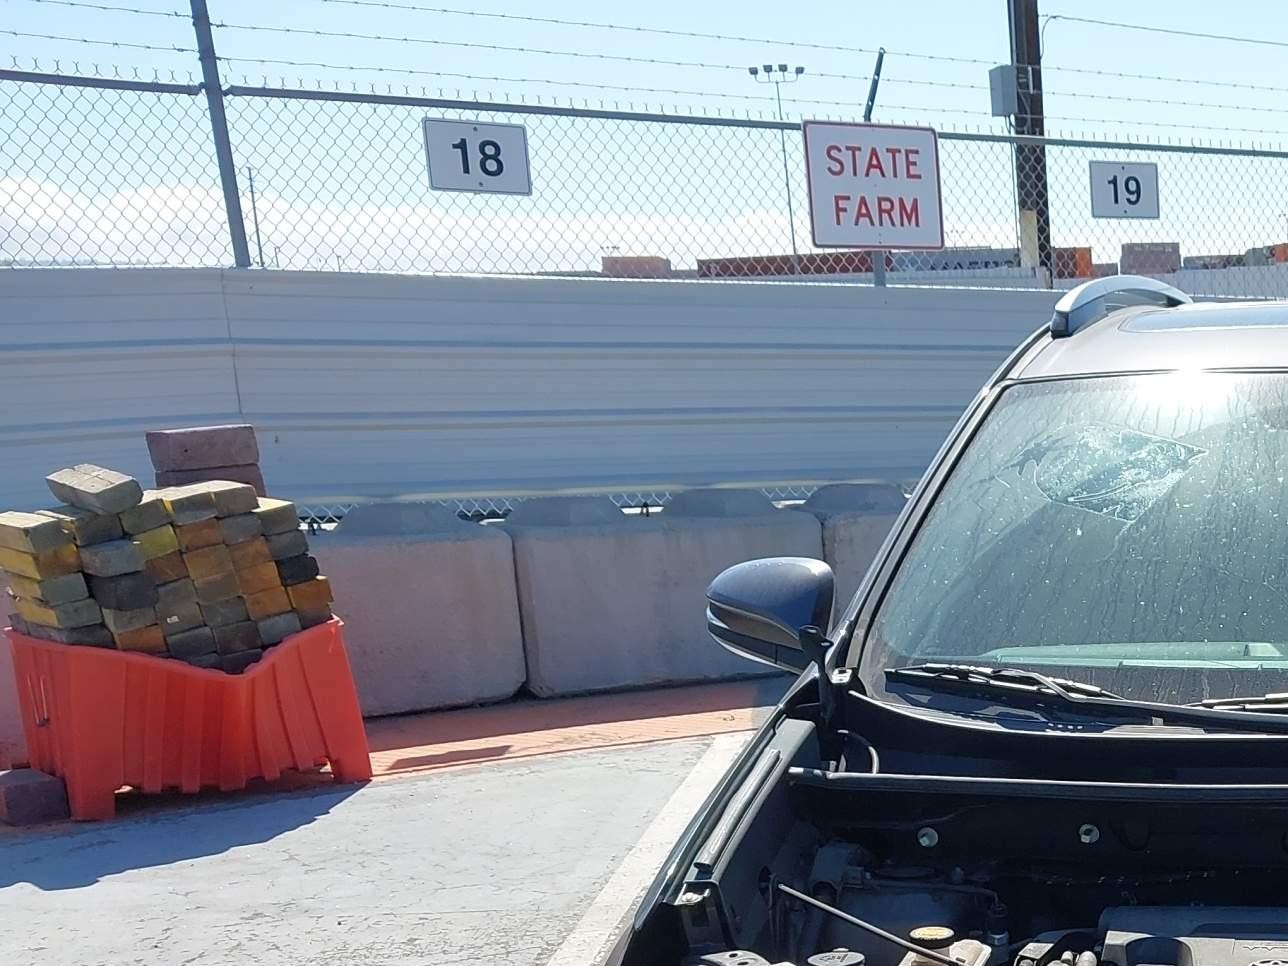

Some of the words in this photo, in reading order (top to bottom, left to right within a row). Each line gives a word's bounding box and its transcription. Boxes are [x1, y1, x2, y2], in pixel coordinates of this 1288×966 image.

[451, 137, 505, 178] 18
[825, 144, 923, 180] STATE
[1107, 174, 1142, 206] 19
[833, 194, 921, 228] FARM
